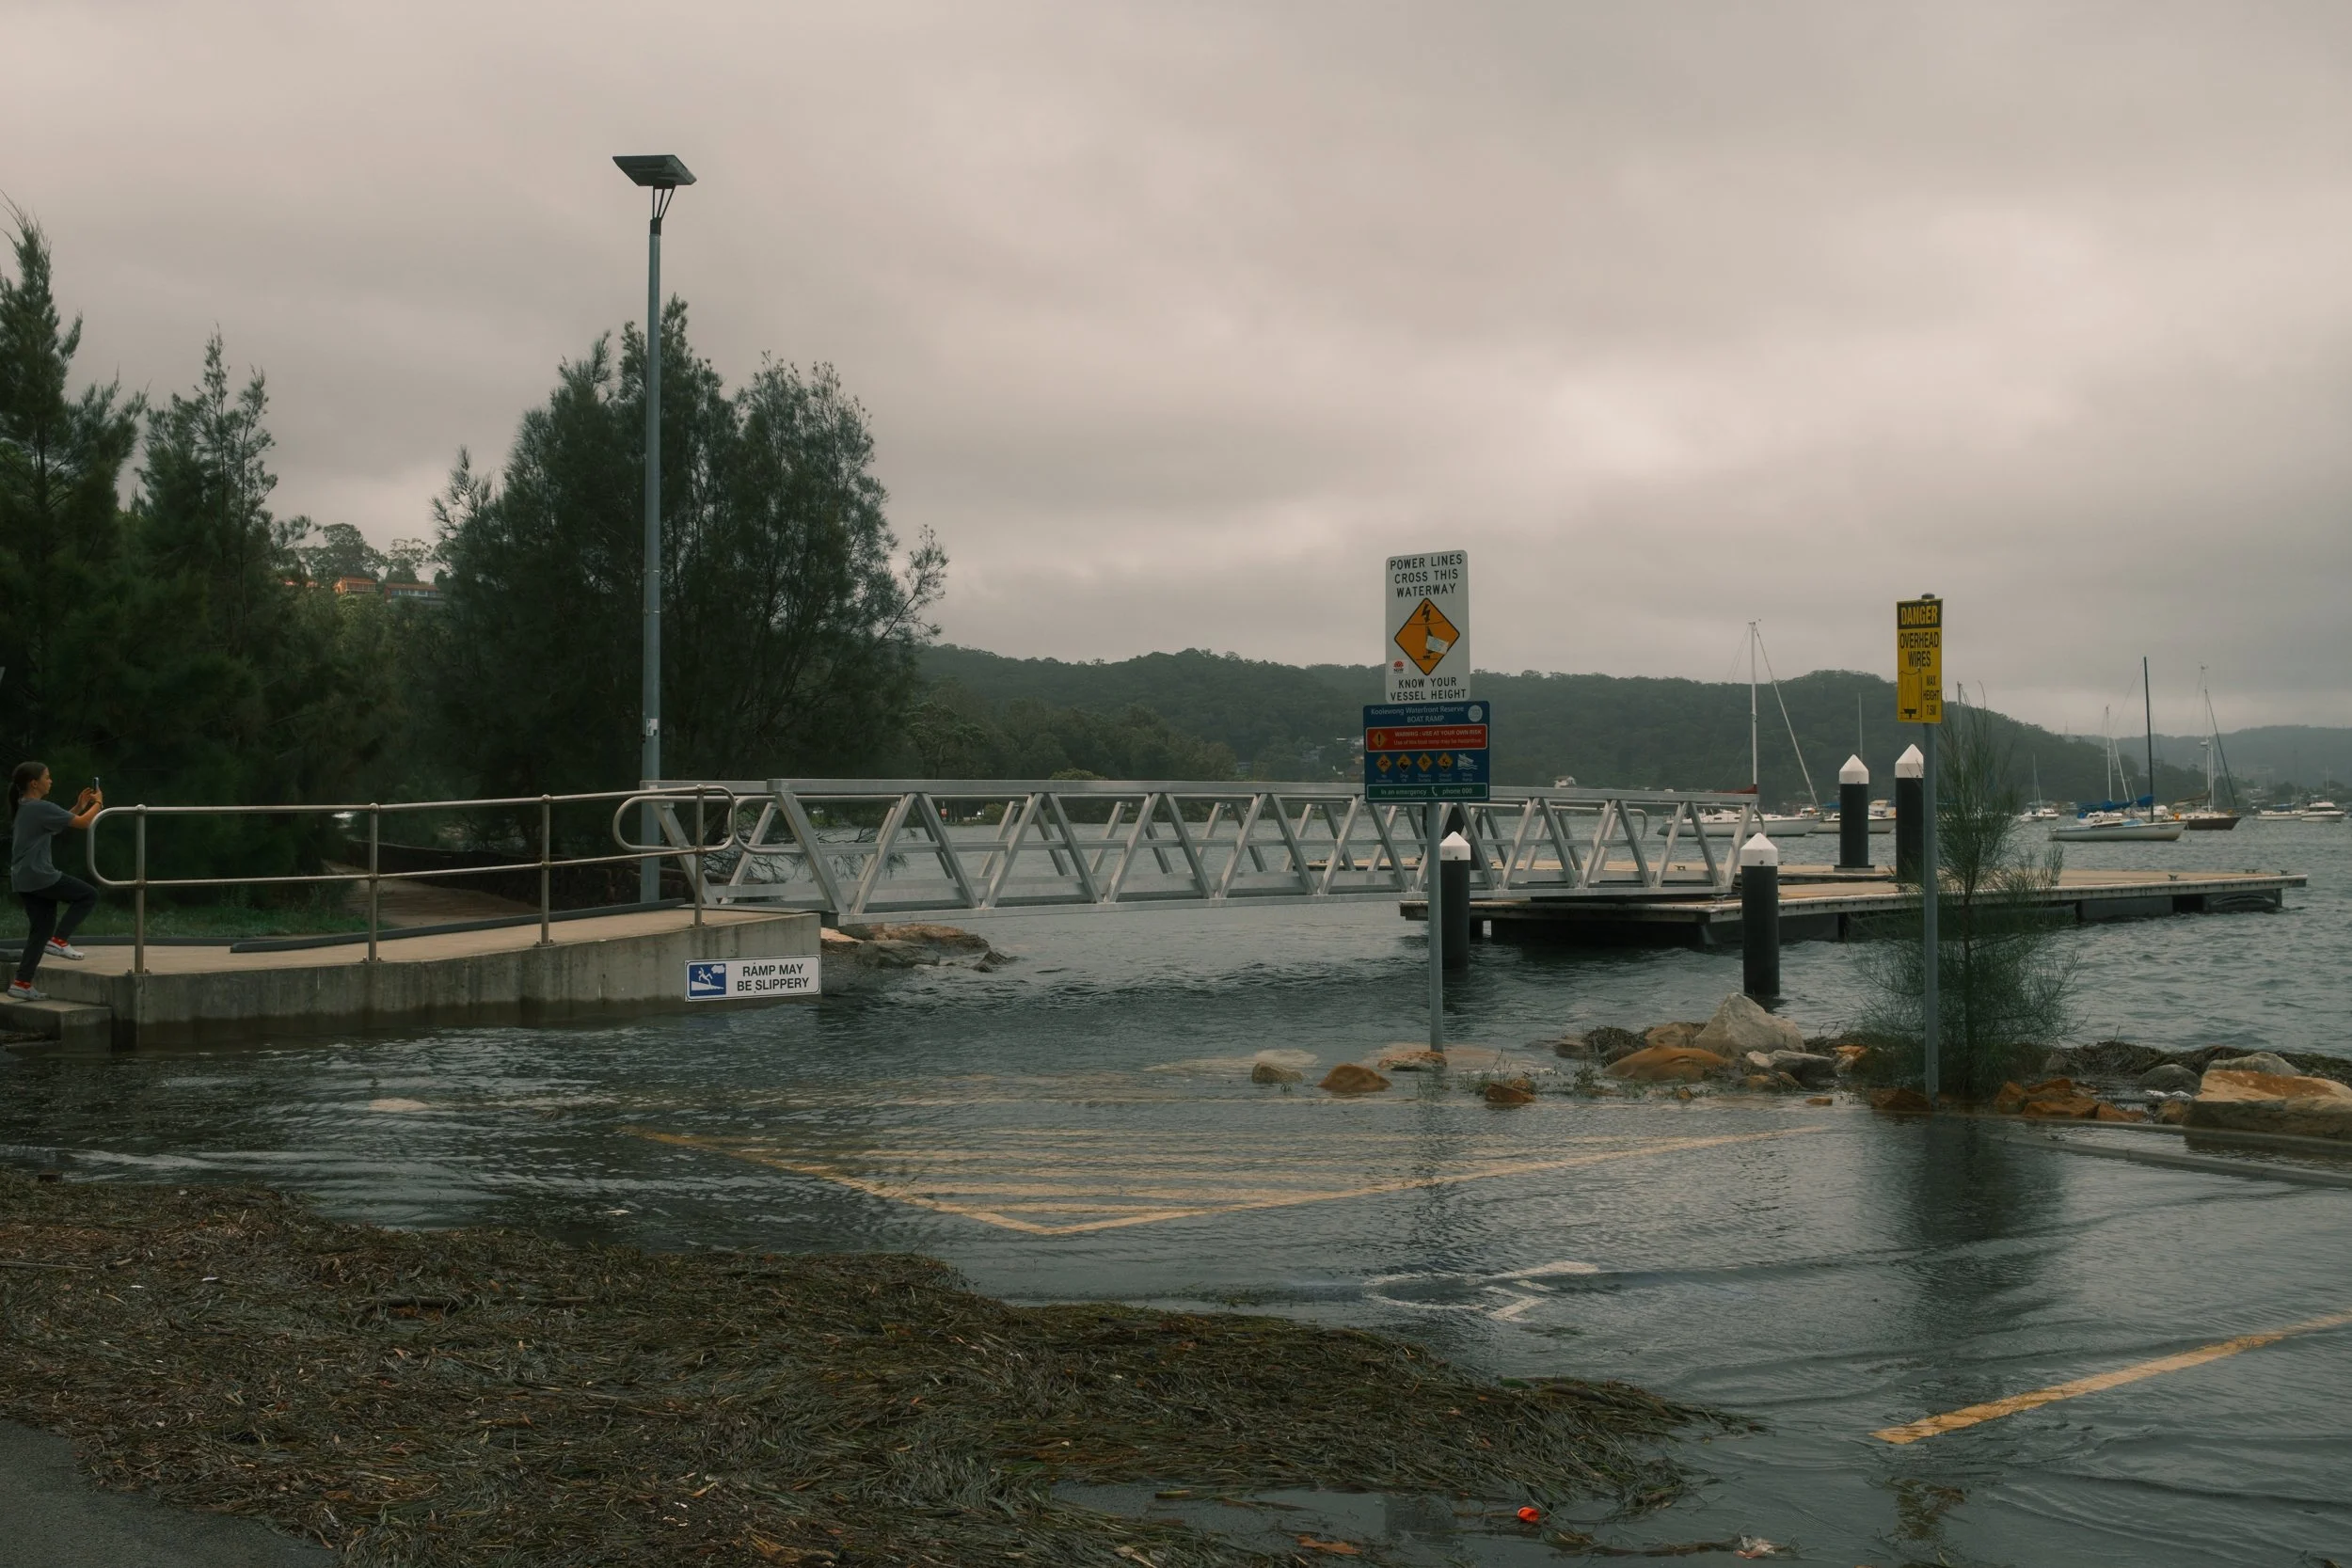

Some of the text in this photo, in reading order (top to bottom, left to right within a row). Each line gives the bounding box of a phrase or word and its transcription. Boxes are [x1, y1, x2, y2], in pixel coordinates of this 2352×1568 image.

[1390, 553, 1463, 571] POWER LINES
[1394, 568, 1458, 584] CROSS THIS
[1396, 582, 1456, 598] WATERWAY
[1900, 605, 1938, 626] DANGER
[1899, 631, 1940, 649] OVERHEAD
[1907, 650, 1931, 667] WIRES
[1398, 676, 1457, 689] KNOW YOUR
[1390, 689, 1467, 702] VESSEL HEIGHT
[1406, 705, 1438, 714] Waterfront
[742, 963, 804, 977] RAMP MAY
[737, 977, 809, 991] BE SLIPPERY
